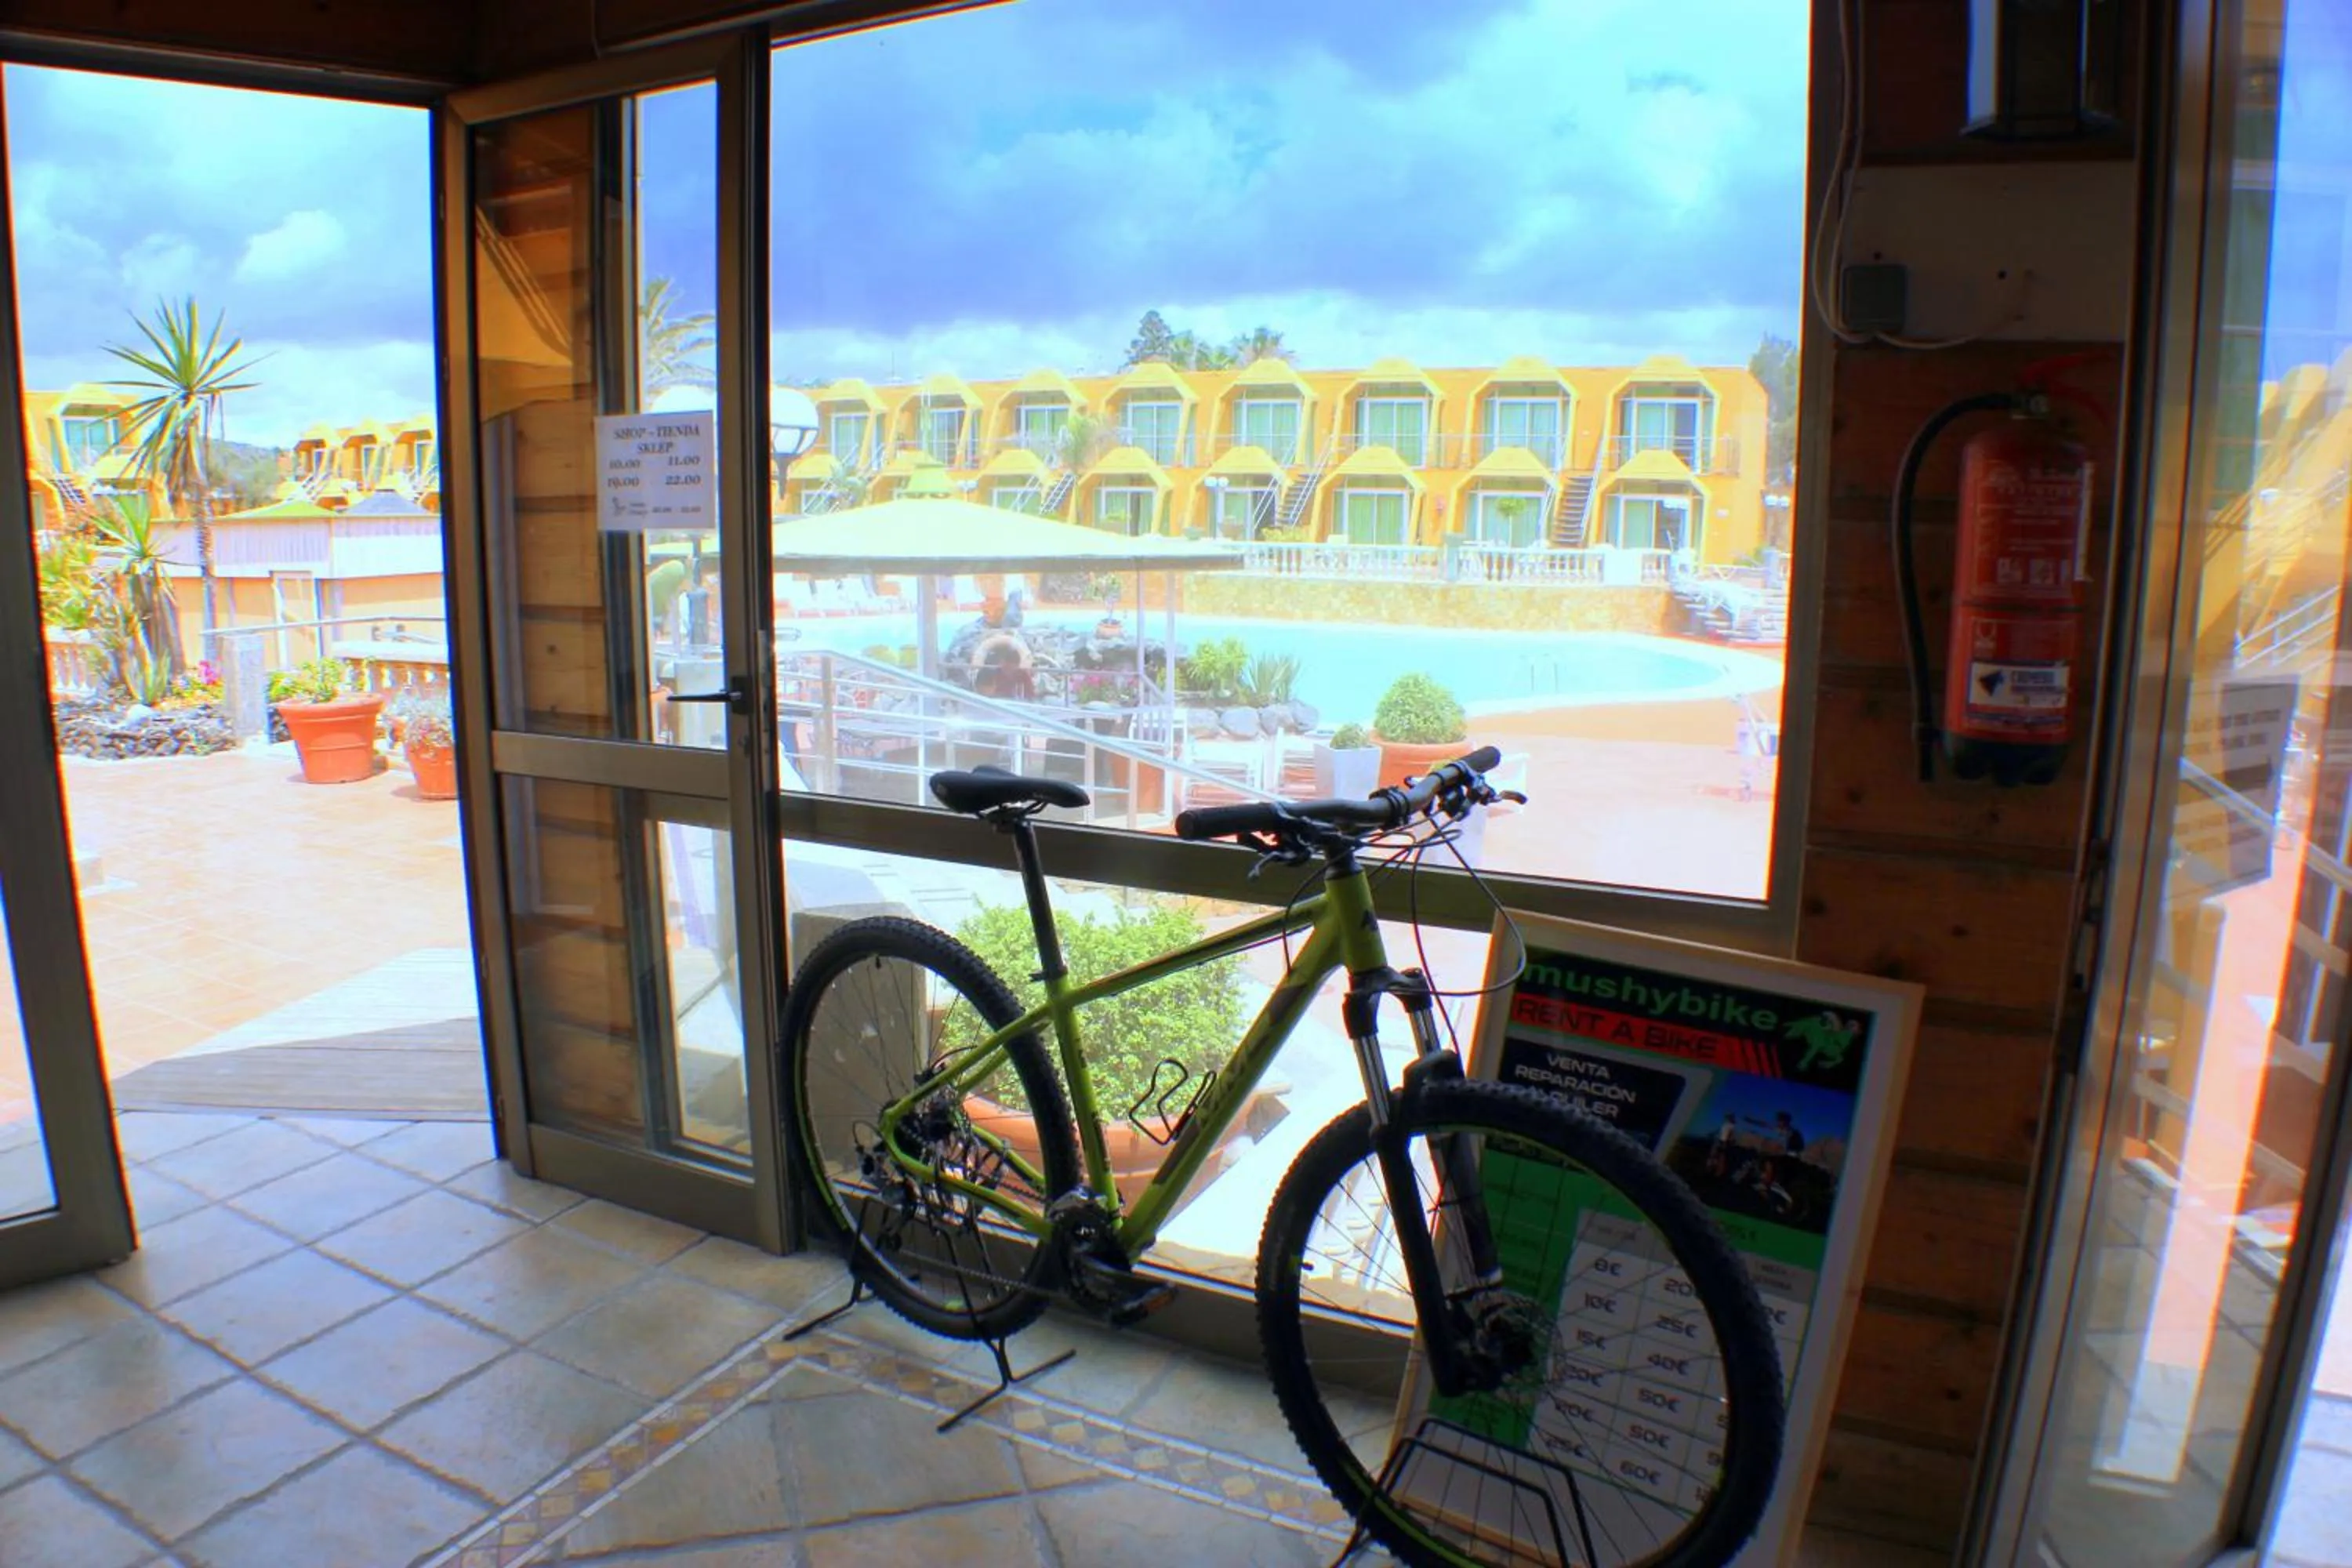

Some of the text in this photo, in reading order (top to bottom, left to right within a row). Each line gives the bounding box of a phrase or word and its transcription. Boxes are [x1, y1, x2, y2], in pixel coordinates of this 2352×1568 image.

[613, 427, 646, 439] SHOP
[655, 425, 700, 437] TIENDA
[637, 441, 673, 454] SKLEP
[665, 474, 702, 486] 22.00
[1524, 963, 1780, 1032] mushybike
[1515, 995, 1719, 1059] RENT A BIKE
[1546, 1051, 1611, 1080] VENTA
[1514, 1065, 1637, 1105] REPARACIÓN
[1594, 1256, 1622, 1278] 8€
[1584, 1292, 1699, 1340] 10€ 25€
[1576, 1328, 1690, 1376] 15€ 40€
[1636, 1387, 1681, 1413] 50€
[1628, 1425, 1671, 1450] 50€
